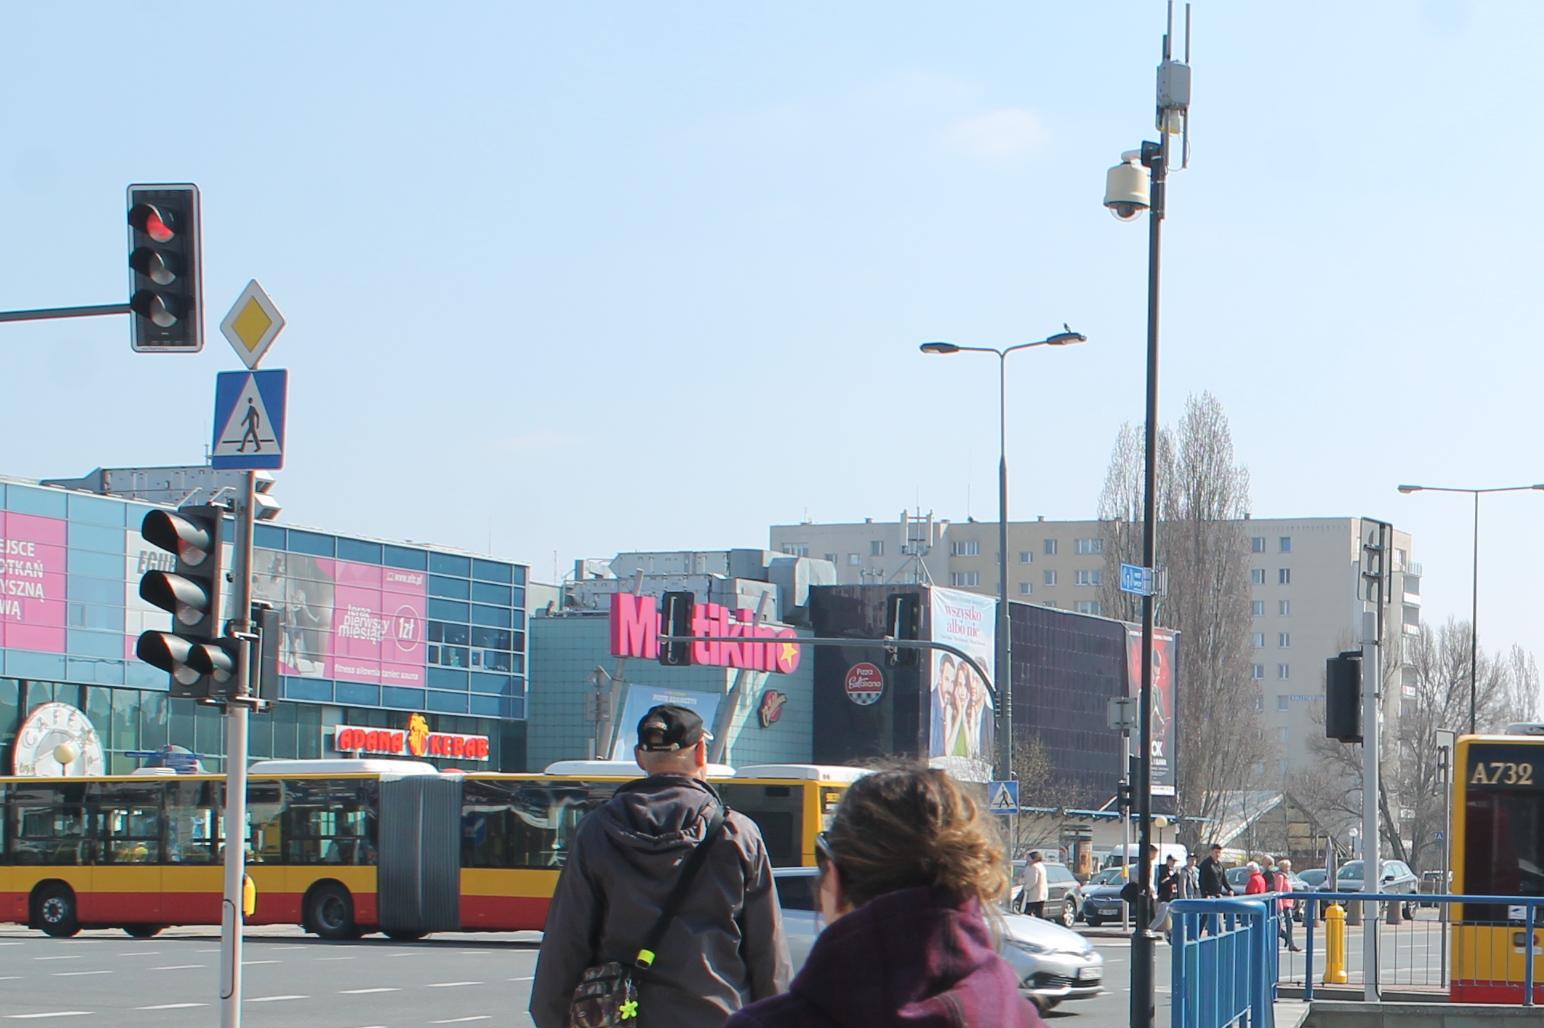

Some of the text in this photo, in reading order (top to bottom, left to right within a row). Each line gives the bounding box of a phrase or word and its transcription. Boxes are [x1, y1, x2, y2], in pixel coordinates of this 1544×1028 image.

[943, 604, 982, 622] wszystko
[611, 592, 800, 674] Mtikino
[946, 618, 965, 635] albo
[340, 728, 403, 753] ADANA
[429, 735, 489, 759] KEBAB
[1470, 762, 1533, 784] A732
